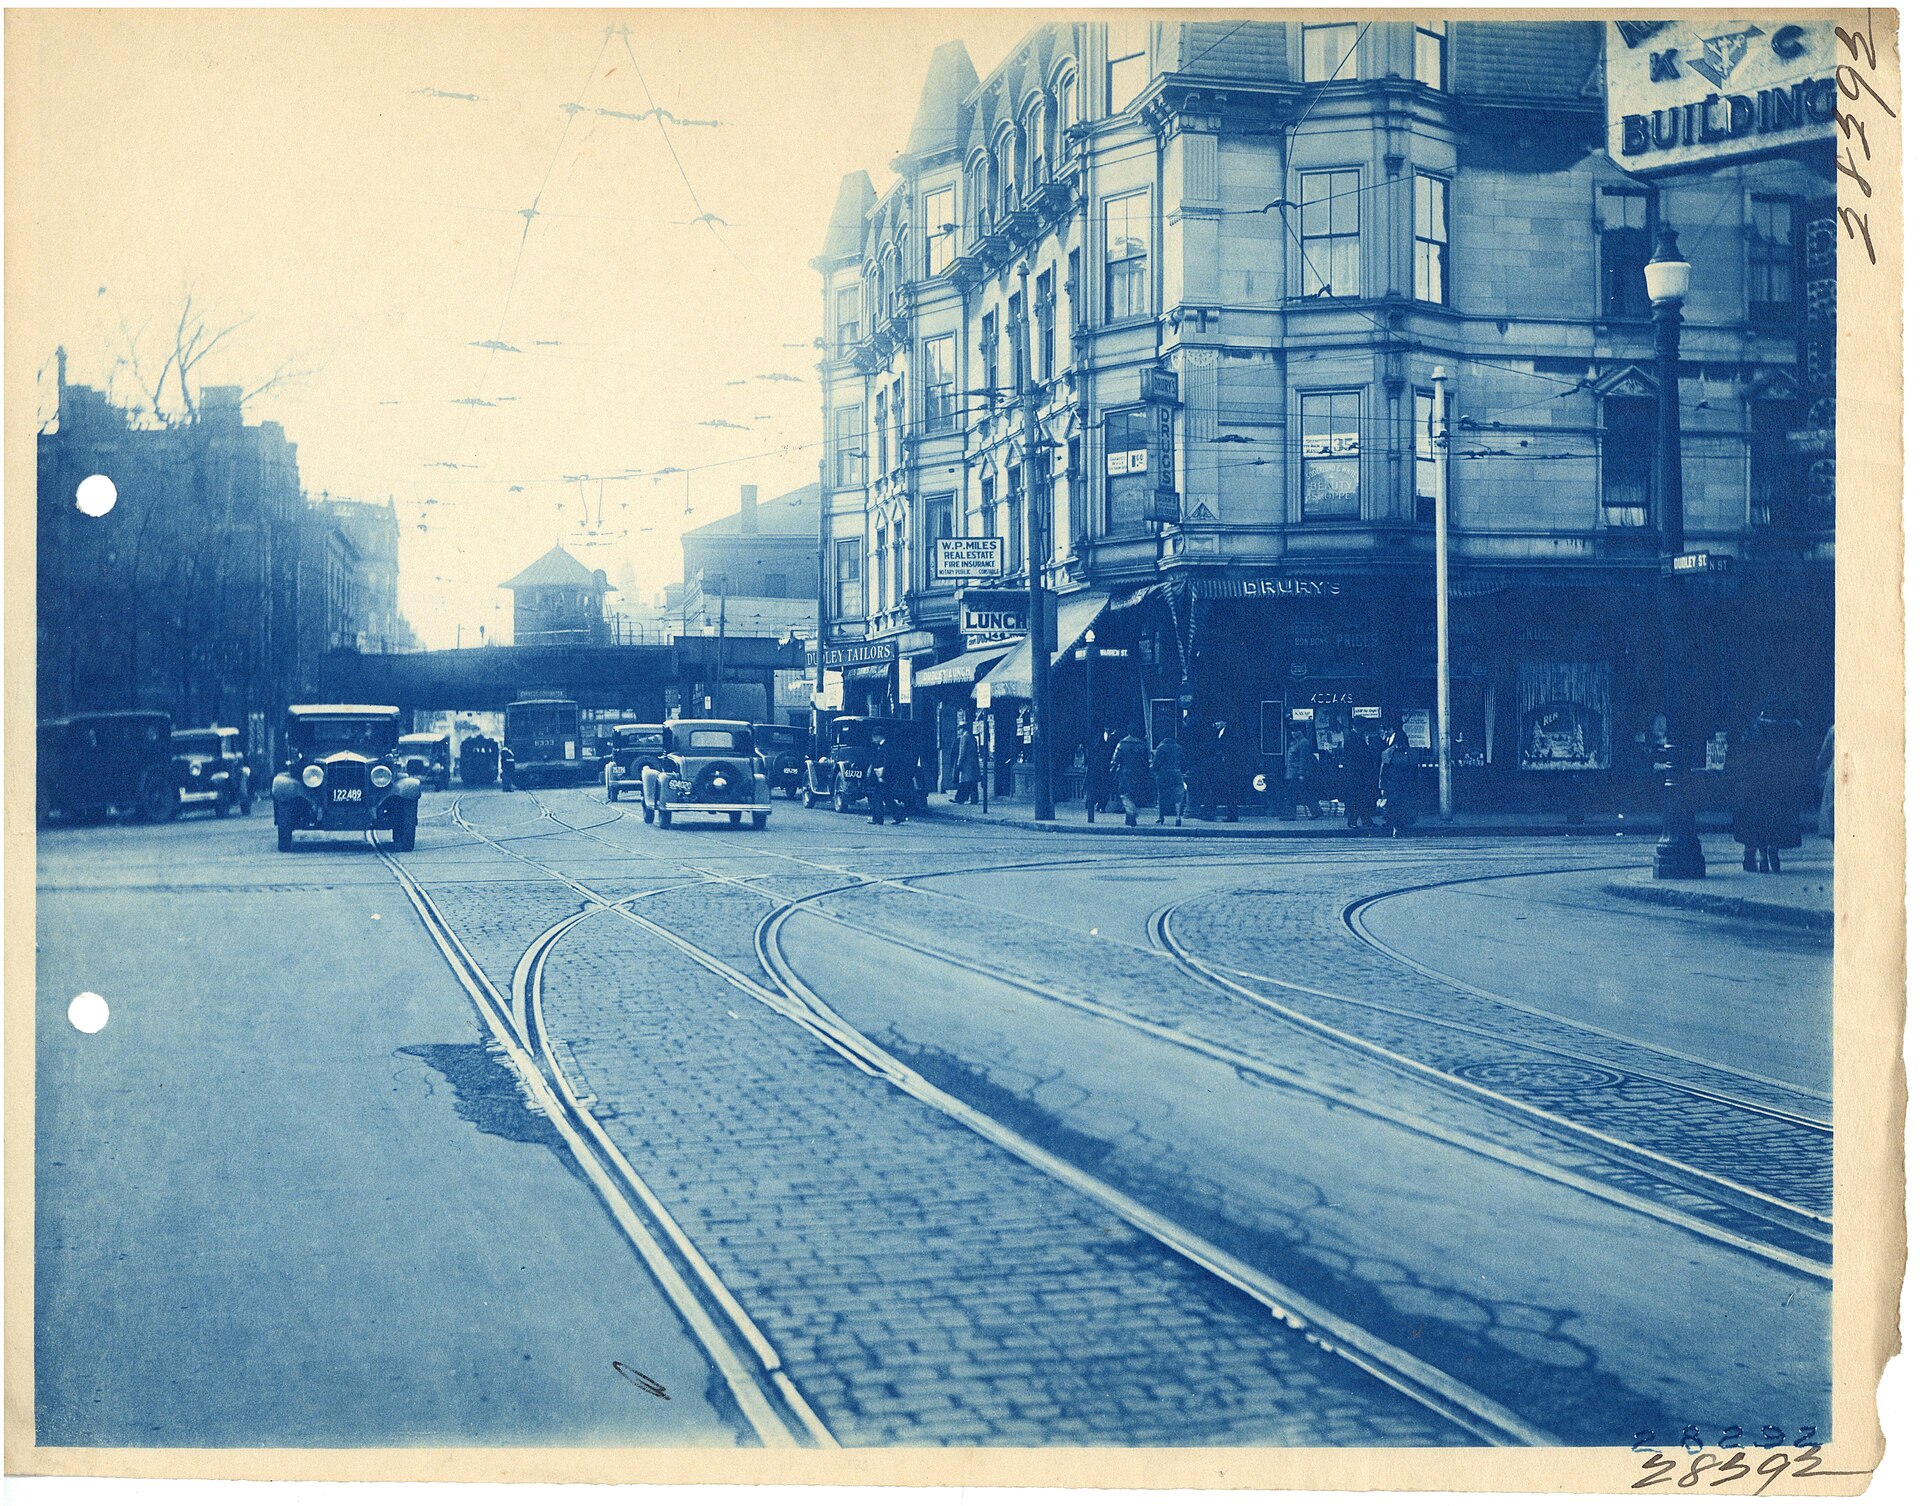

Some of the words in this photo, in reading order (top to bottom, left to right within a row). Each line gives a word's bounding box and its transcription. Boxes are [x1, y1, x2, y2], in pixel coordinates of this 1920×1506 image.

[1650, 49, 1681, 82] K
[1771, 25, 1806, 59] C
[1621, 77, 1837, 156] BUILDING
[1154, 376, 1176, 395] DRURY'S
[1161, 407, 1171, 485] DRUGS
[1310, 480, 1353, 491] BEAUTY
[944, 551, 966, 560] REAL
[966, 551, 995, 559] ESTATE
[1673, 555, 1697, 570] DUDLEY
[944, 560, 960, 568] FIRE
[961, 560, 996, 568] INSURANCE
[1243, 580, 1341, 596] DRURY'S
[965, 612, 1027, 629] LUNCH
[847, 645, 892, 661] TAILORS
[947, 666, 971, 679] LUNCH
